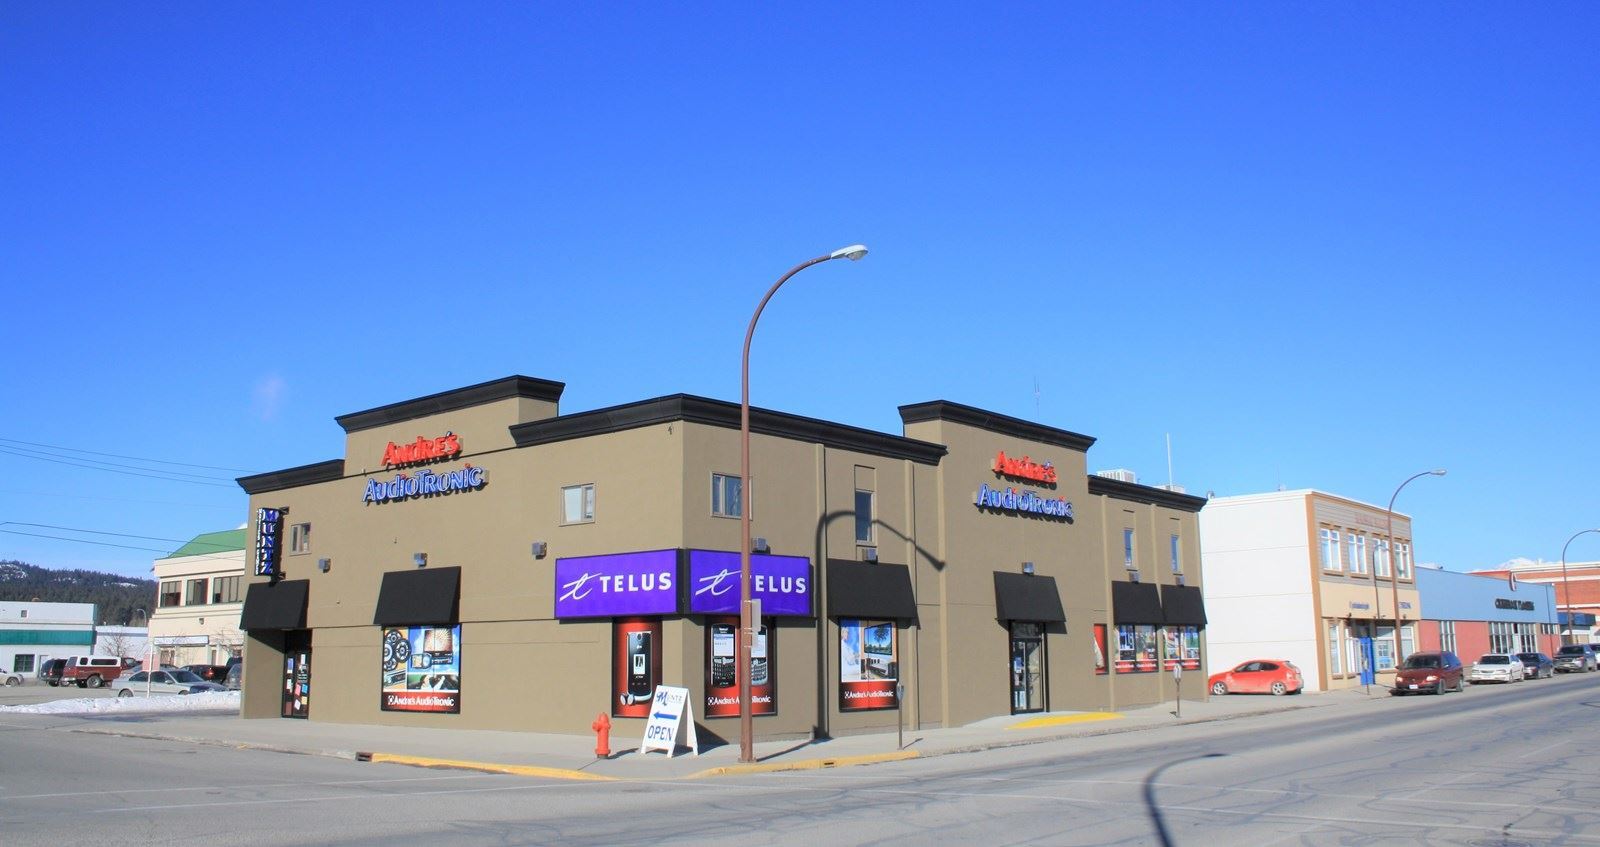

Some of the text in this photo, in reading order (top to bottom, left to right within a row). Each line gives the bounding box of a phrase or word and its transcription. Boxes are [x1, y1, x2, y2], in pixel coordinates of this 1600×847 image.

[600, 572, 672, 593] TELUS
[741, 573, 806, 593] ELUS
[647, 725, 675, 741] OPEN
